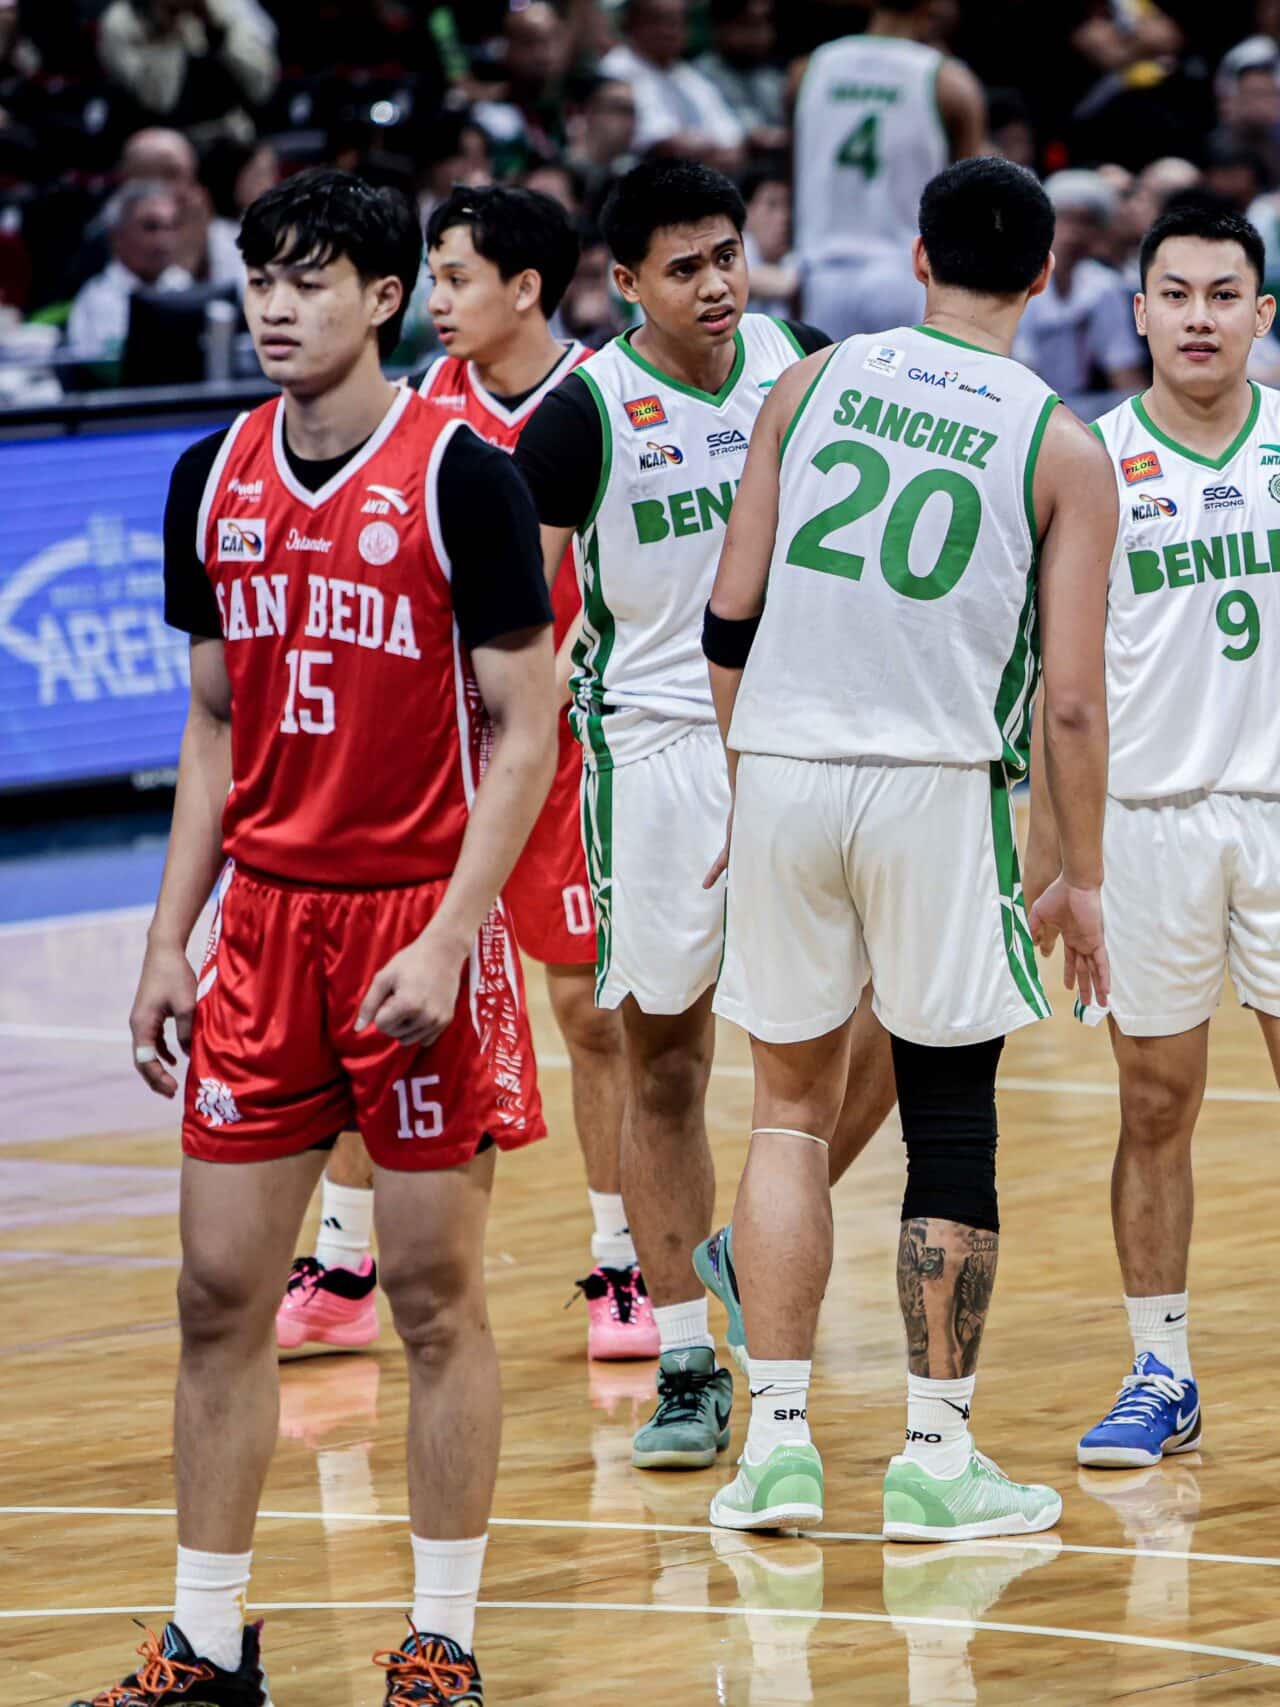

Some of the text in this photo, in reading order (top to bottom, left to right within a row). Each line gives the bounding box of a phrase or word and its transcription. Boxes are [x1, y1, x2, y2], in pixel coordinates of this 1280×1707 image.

[836, 113, 882, 180] 4
[907, 367, 947, 388] GMA
[706, 429, 746, 448] SGA
[708, 443, 748, 457] STRONG
[833, 389, 998, 470] SANCHEZ
[638, 450, 667, 470] NCAA
[1125, 459, 1157, 475] FILOIL
[360, 499, 389, 515] ANTA
[632, 479, 741, 545] BEN
[1131, 504, 1160, 521] NCAA
[1203, 485, 1242, 502] SGA
[1204, 498, 1245, 511] STRONG
[786, 439, 982, 601] 20
[215, 574, 289, 641] SAN
[304, 574, 422, 661] BEDA
[1215, 589, 1261, 662] 9
[37, 608, 191, 705] AREN
[280, 650, 336, 735] 15
[562, 885, 591, 935] 0
[393, 1075, 444, 1139] 15
